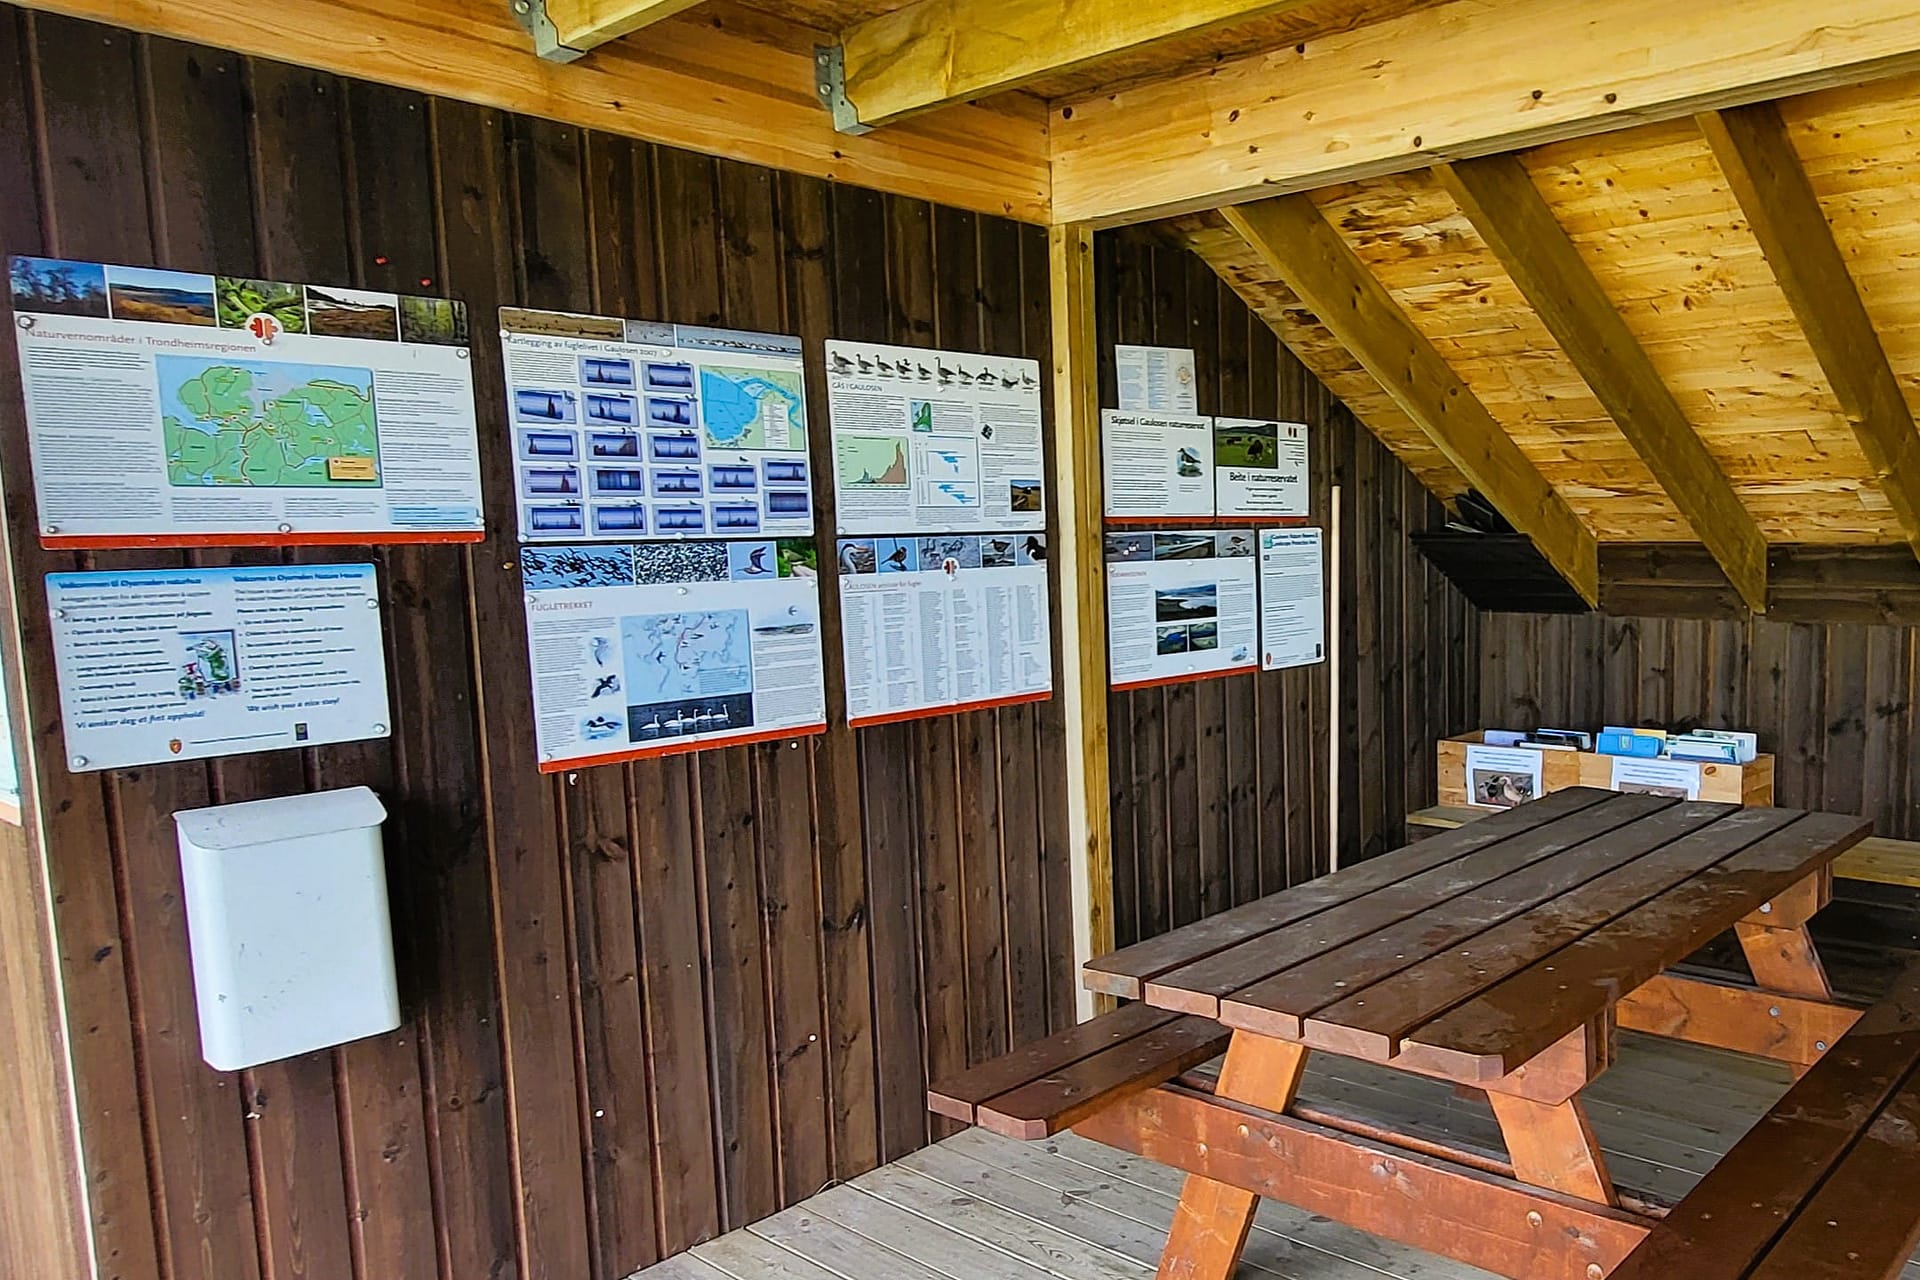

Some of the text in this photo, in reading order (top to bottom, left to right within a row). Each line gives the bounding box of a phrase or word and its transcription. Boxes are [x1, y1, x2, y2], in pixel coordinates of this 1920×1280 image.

[25, 328, 256, 353] Naturvernområder i Trondheimsregionen
